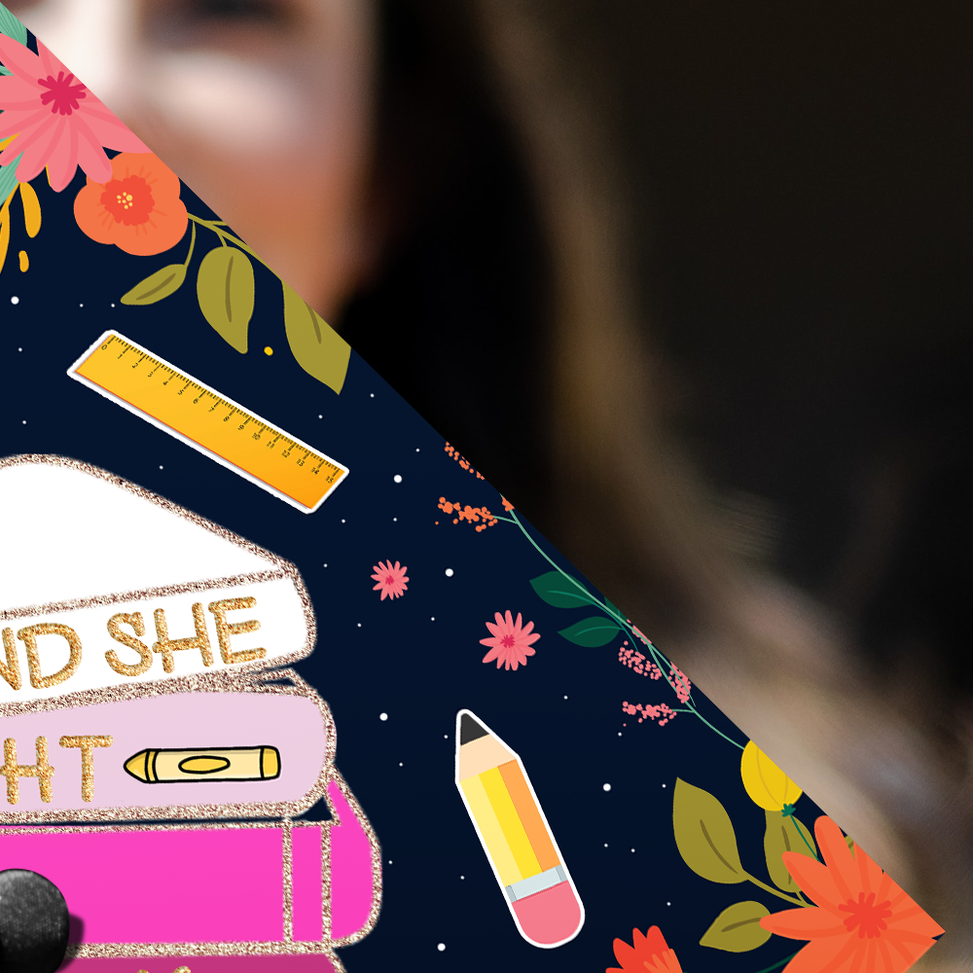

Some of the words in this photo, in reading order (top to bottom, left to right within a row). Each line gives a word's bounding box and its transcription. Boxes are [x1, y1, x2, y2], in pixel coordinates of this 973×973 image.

[252, 432, 261, 440] 10
[266, 441, 275, 449] 11
[281, 449, 290, 458] 12
[296, 458, 305, 467] 13
[311, 467, 320, 475] 14
[325, 475, 334, 484] 15
[104, 596, 267, 676] SHE
